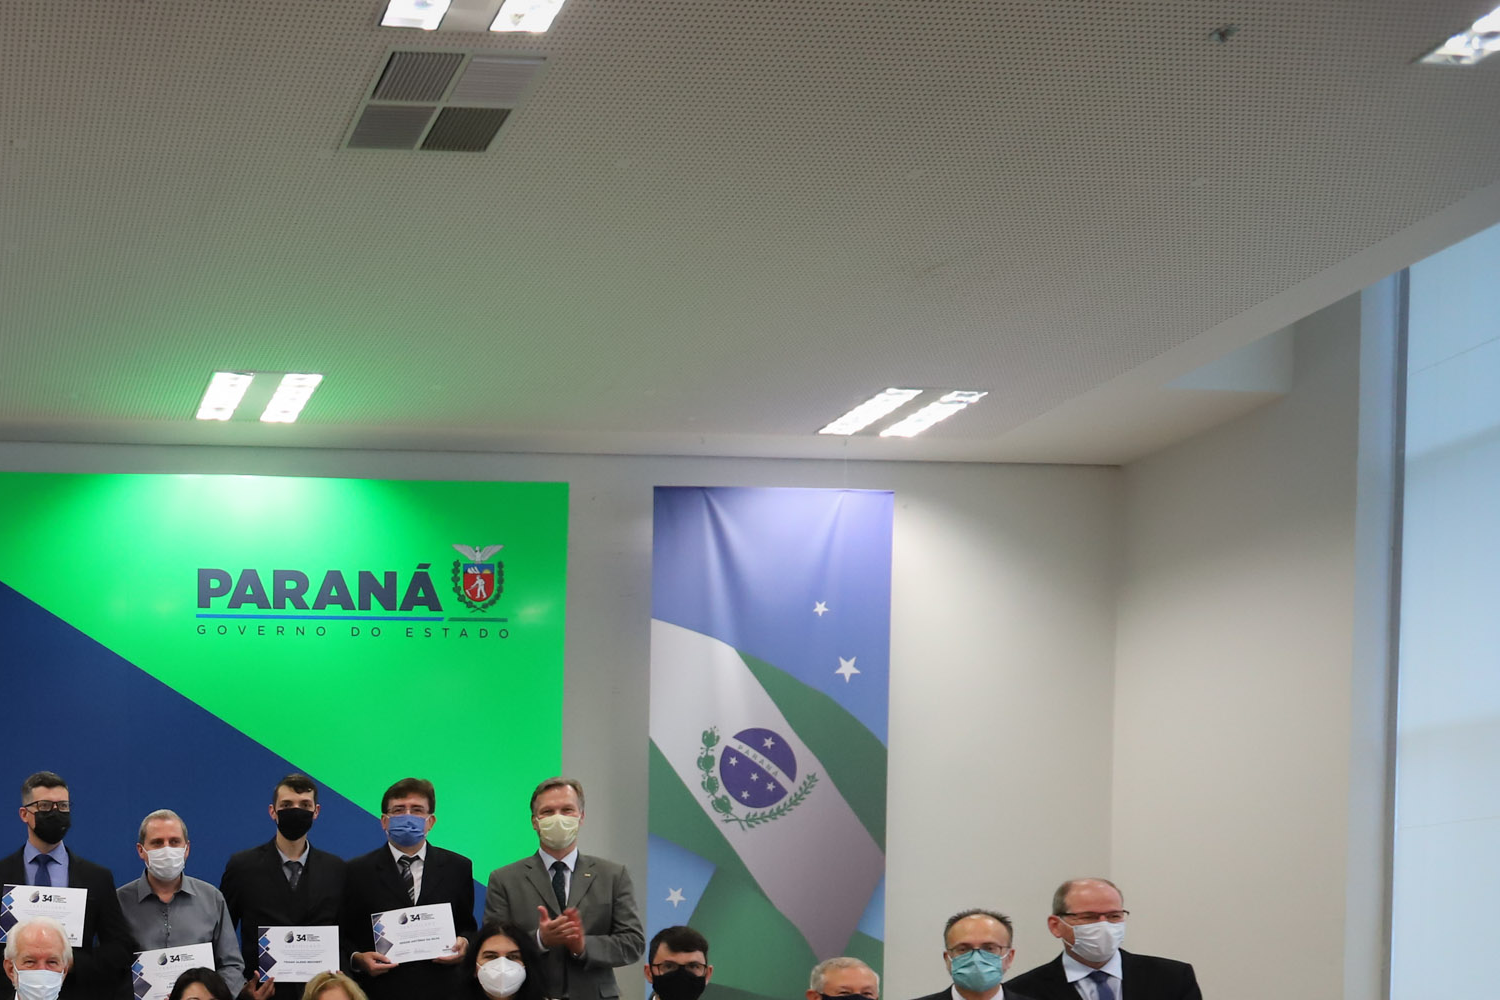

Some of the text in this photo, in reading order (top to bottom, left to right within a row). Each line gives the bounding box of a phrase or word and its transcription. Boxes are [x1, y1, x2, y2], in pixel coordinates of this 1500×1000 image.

[197, 563, 444, 612] PARANÁ
[197, 624, 509, 640] GOVERNO DO ESTADO
[41, 894, 52, 902] 34
[410, 914, 420, 922] 34
[296, 934, 306, 942] 34
[169, 955, 180, 963] 34
